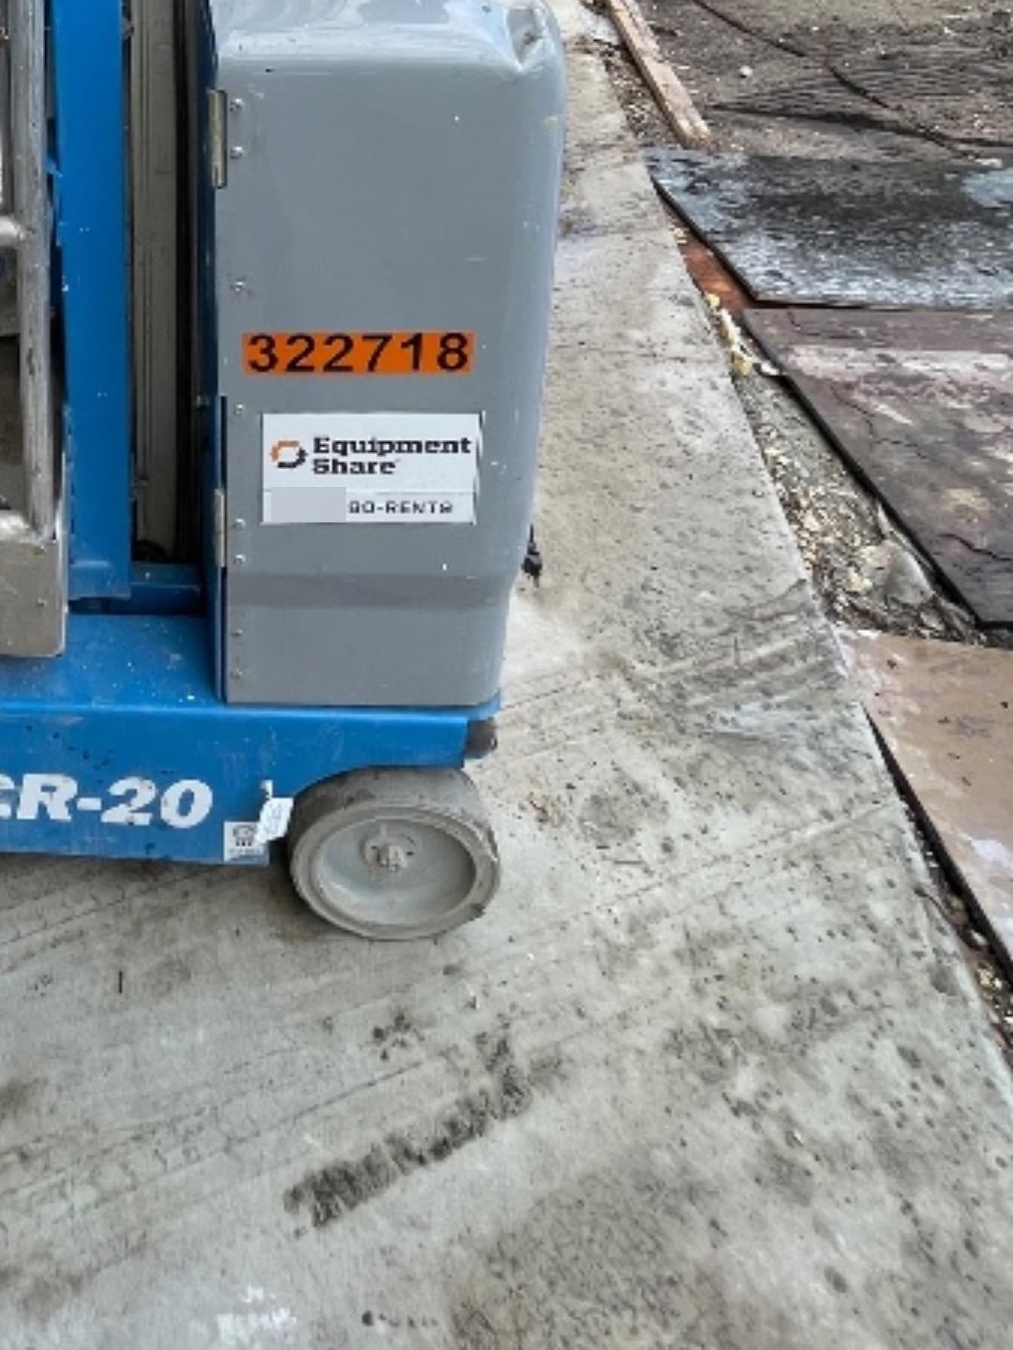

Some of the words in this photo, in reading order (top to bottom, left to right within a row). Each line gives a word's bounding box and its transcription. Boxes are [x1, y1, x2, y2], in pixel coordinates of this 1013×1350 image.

[247, 332, 469, 373] 322718
[313, 436, 472, 455] Equipment
[313, 458, 397, 475] Share
